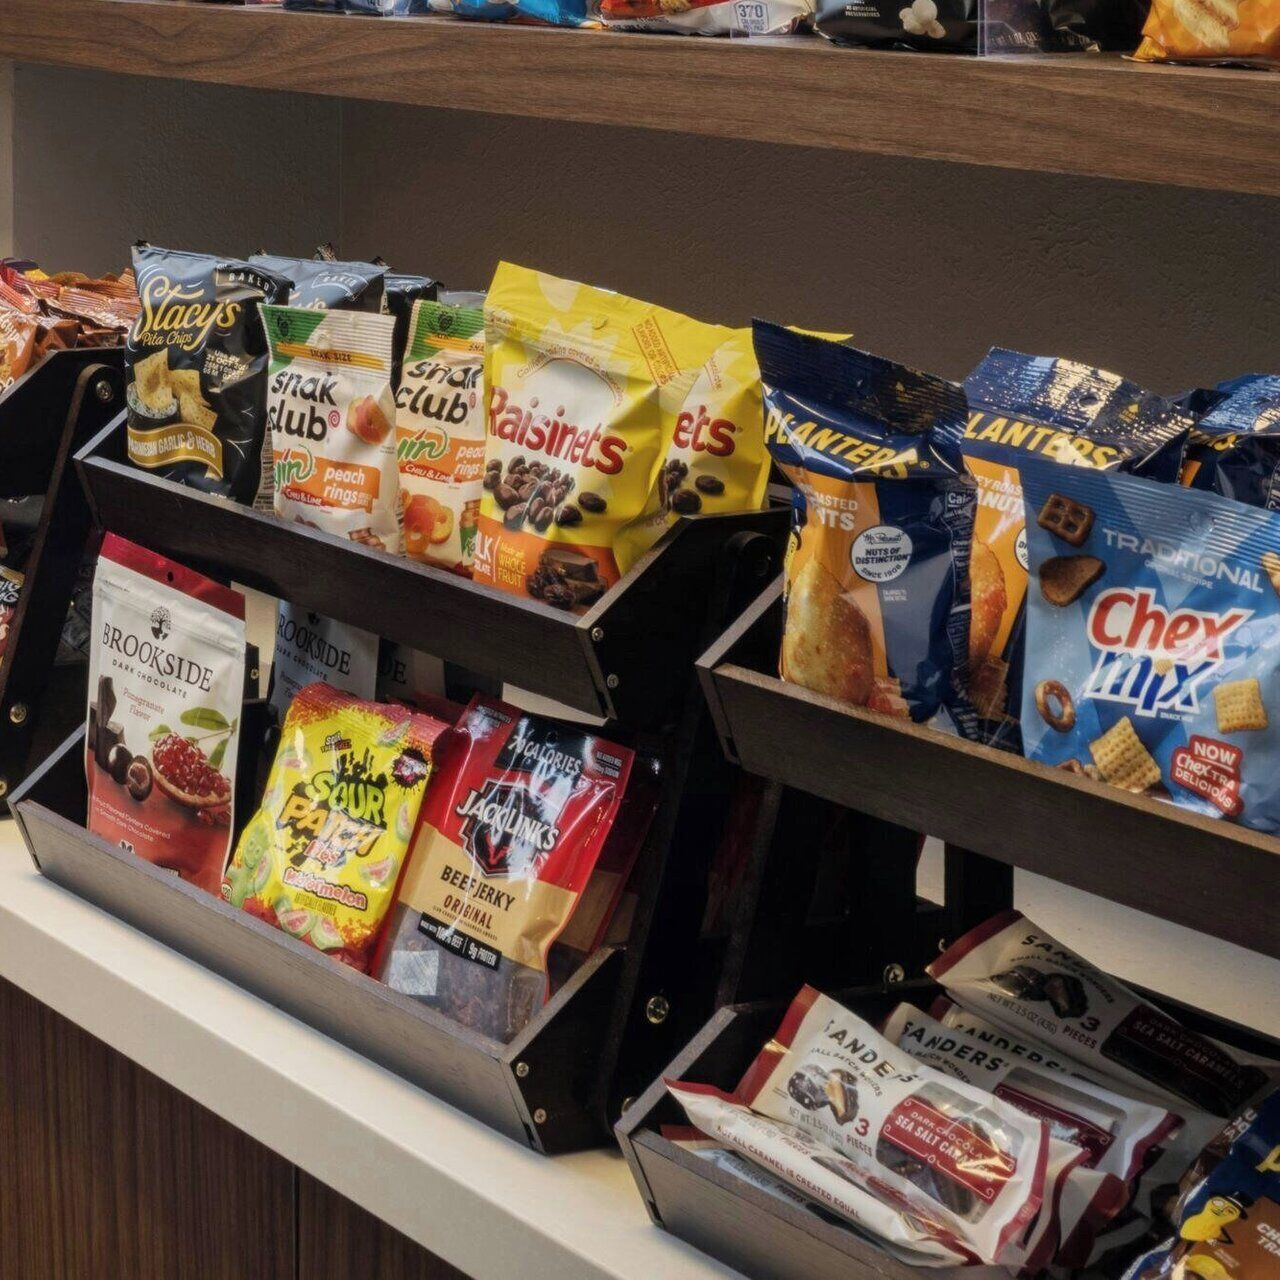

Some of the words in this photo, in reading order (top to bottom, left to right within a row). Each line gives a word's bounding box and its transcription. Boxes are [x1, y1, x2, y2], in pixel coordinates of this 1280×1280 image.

[229, 272, 270, 292] BAKED
[134, 275, 241, 351] Stacy's
[143, 332, 164, 346] Pita
[167, 332, 193, 347] Chips
[271, 371, 339, 406] snak
[395, 386, 469, 424] club
[490, 385, 628, 475] Raisinets
[765, 410, 918, 479] PLANTERS
[323, 465, 365, 484] peach
[324, 484, 358, 502] rings
[498, 555, 526, 575] WHOLE
[855, 554, 909, 564] DISTINCTION
[865, 548, 889, 556] NUTS
[1101, 527, 1265, 593] TRADITIONAL
[498, 568, 523, 587] FRUIT
[861, 567, 882, 578] SINCE
[1091, 591, 1239, 660] Chex
[103, 622, 213, 692] BROOKSIDE
[112, 659, 134, 675] DARK
[137, 673, 187, 699] CHOCOLATE
[1091, 653, 1214, 715] mix
[524, 741, 582, 774] CALORIES
[1194, 741, 1236, 763] NOW
[307, 771, 386, 825] SOUR
[441, 865, 477, 894] BEEF
[472, 878, 516, 911] JERKY
[444, 895, 494, 929] ORIGINAL
[855, 1118, 869, 1137] 3
[895, 1115, 915, 1132] SEA
[915, 1127, 940, 1146] SALT
[847, 1135, 872, 1156] PIECES
[749, 1144, 784, 1170] CARAMEL
[796, 1174, 831, 1200] CREATED
[834, 1198, 860, 1218] EQUAL
